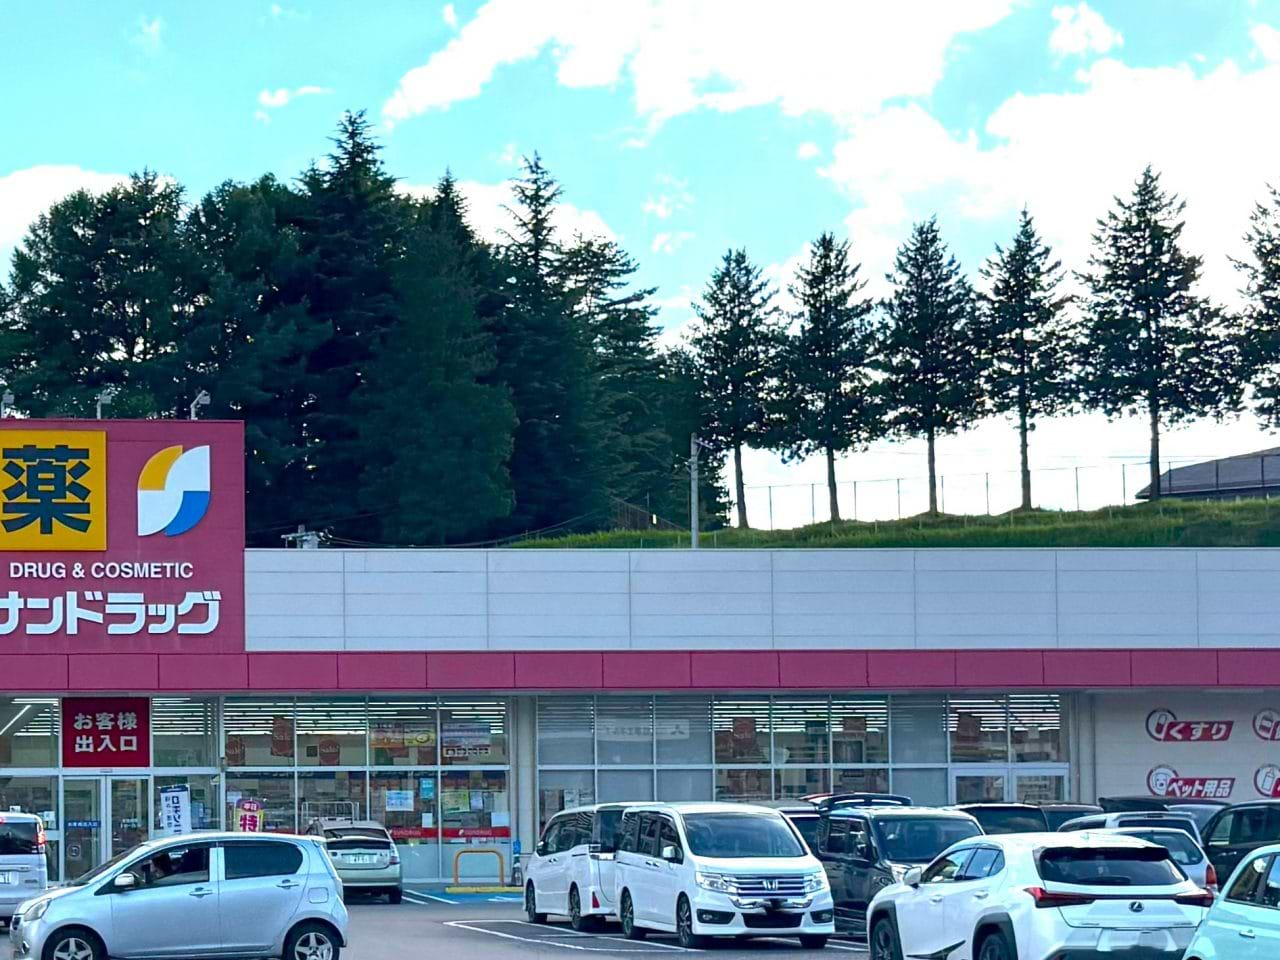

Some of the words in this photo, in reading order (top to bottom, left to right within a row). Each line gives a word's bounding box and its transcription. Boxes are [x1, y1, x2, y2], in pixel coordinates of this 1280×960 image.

[0, 444, 92, 535] 薬
[9, 562, 66, 579] DRUG
[72, 562, 85, 579] &
[91, 562, 194, 579] COSMETIC
[73, 711, 138, 731] お客様
[1169, 722, 1227, 740] くすり
[74, 734, 138, 753] 出入口
[1167, 779, 1232, 797] ペット用品
